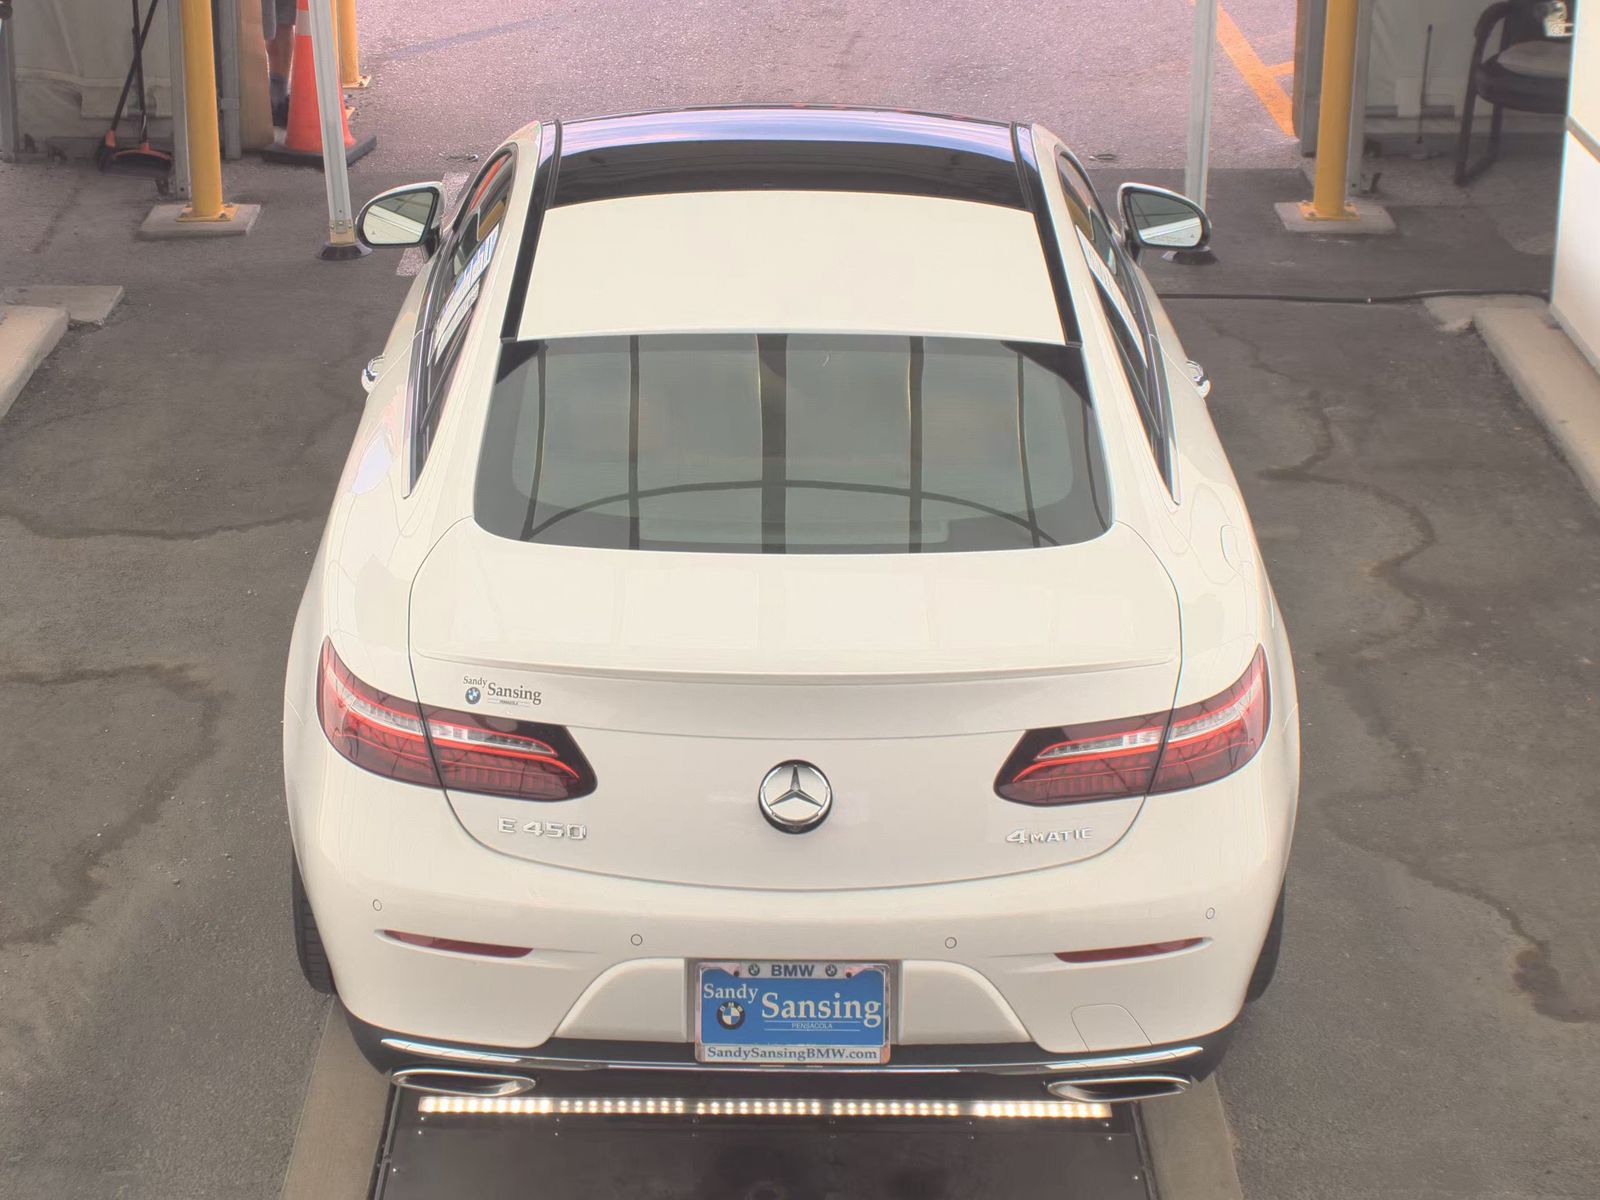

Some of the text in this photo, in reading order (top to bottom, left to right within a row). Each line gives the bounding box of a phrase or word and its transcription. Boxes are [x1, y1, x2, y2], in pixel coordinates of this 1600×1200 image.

[463, 676, 542, 706] Sandy Sansing
[498, 817, 587, 840] E 450
[1005, 827, 1094, 845] 4MATIC
[771, 964, 815, 977] BMW
[703, 983, 881, 1028] Sandy Sansing
[707, 1047, 877, 1061] SandySansingBMW.com
